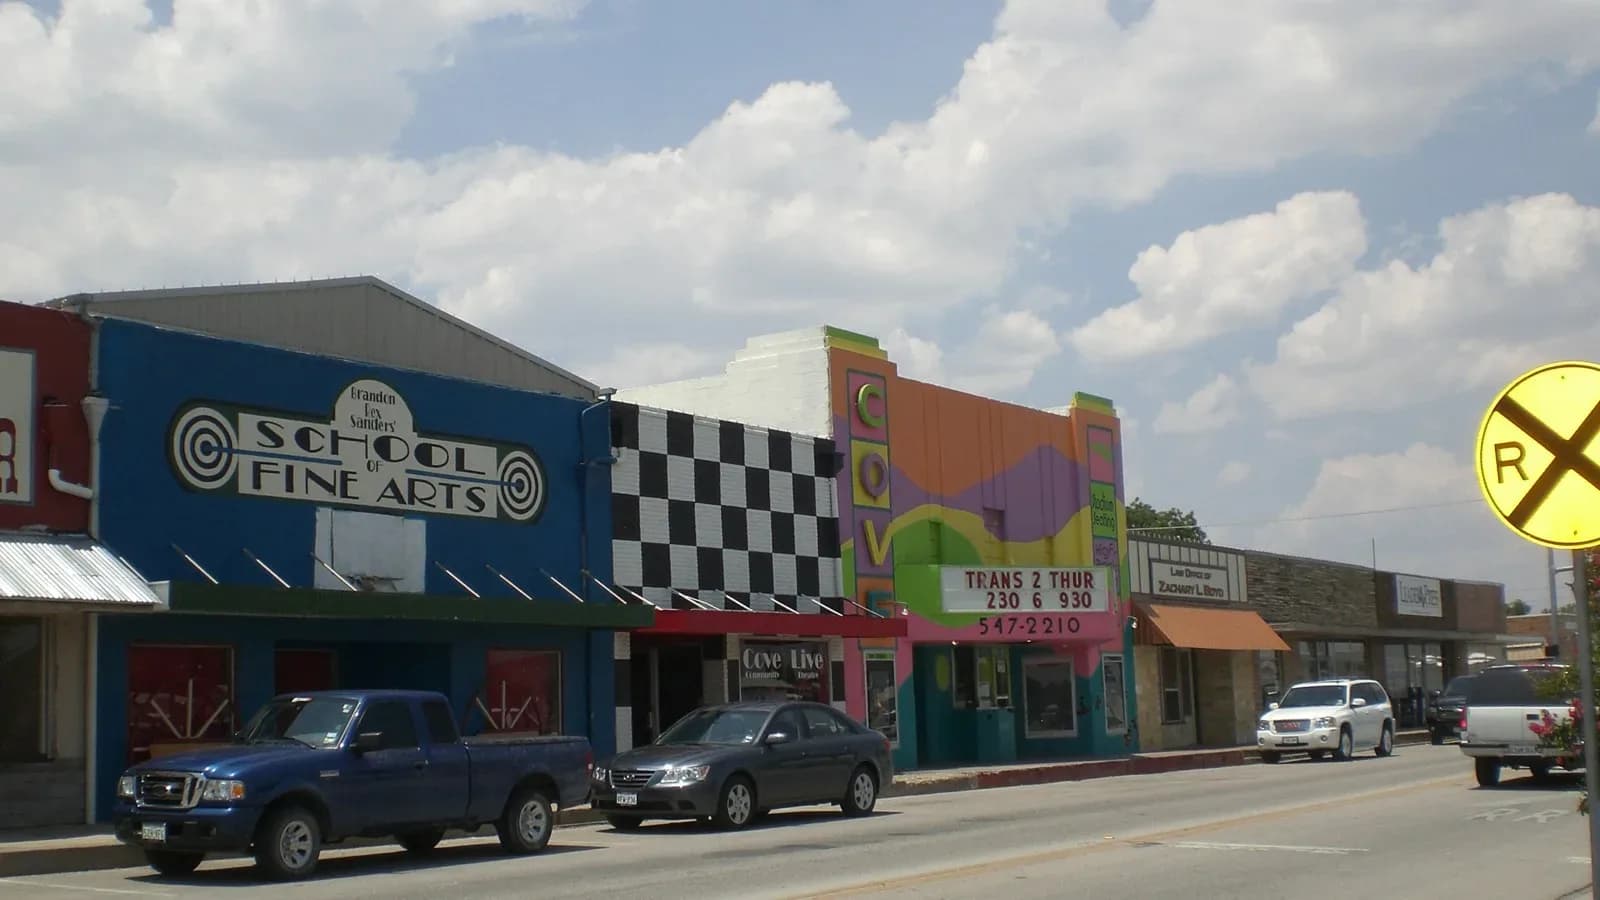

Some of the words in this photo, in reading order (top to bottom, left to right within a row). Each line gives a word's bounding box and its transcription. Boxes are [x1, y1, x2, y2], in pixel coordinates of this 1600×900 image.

[350, 386, 396, 405] Brandon
[364, 402, 382, 419] Rex
[256, 420, 486, 475] SCHOOL
[366, 460, 384, 473] OF
[1495, 441, 1529, 484] R
[252, 461, 360, 500] FINE
[376, 477, 486, 513] ARTS
[965, 571, 1023, 589] TRANS
[1032, 571, 1042, 589] 2
[1050, 571, 1095, 589] THUR
[987, 592, 1020, 609] 230
[1032, 592, 1042, 609] 6
[1059, 592, 1092, 609] 930
[979, 617, 1080, 635] 547-2210
[743, 648, 781, 670] Cove
[791, 648, 824, 670] Live
